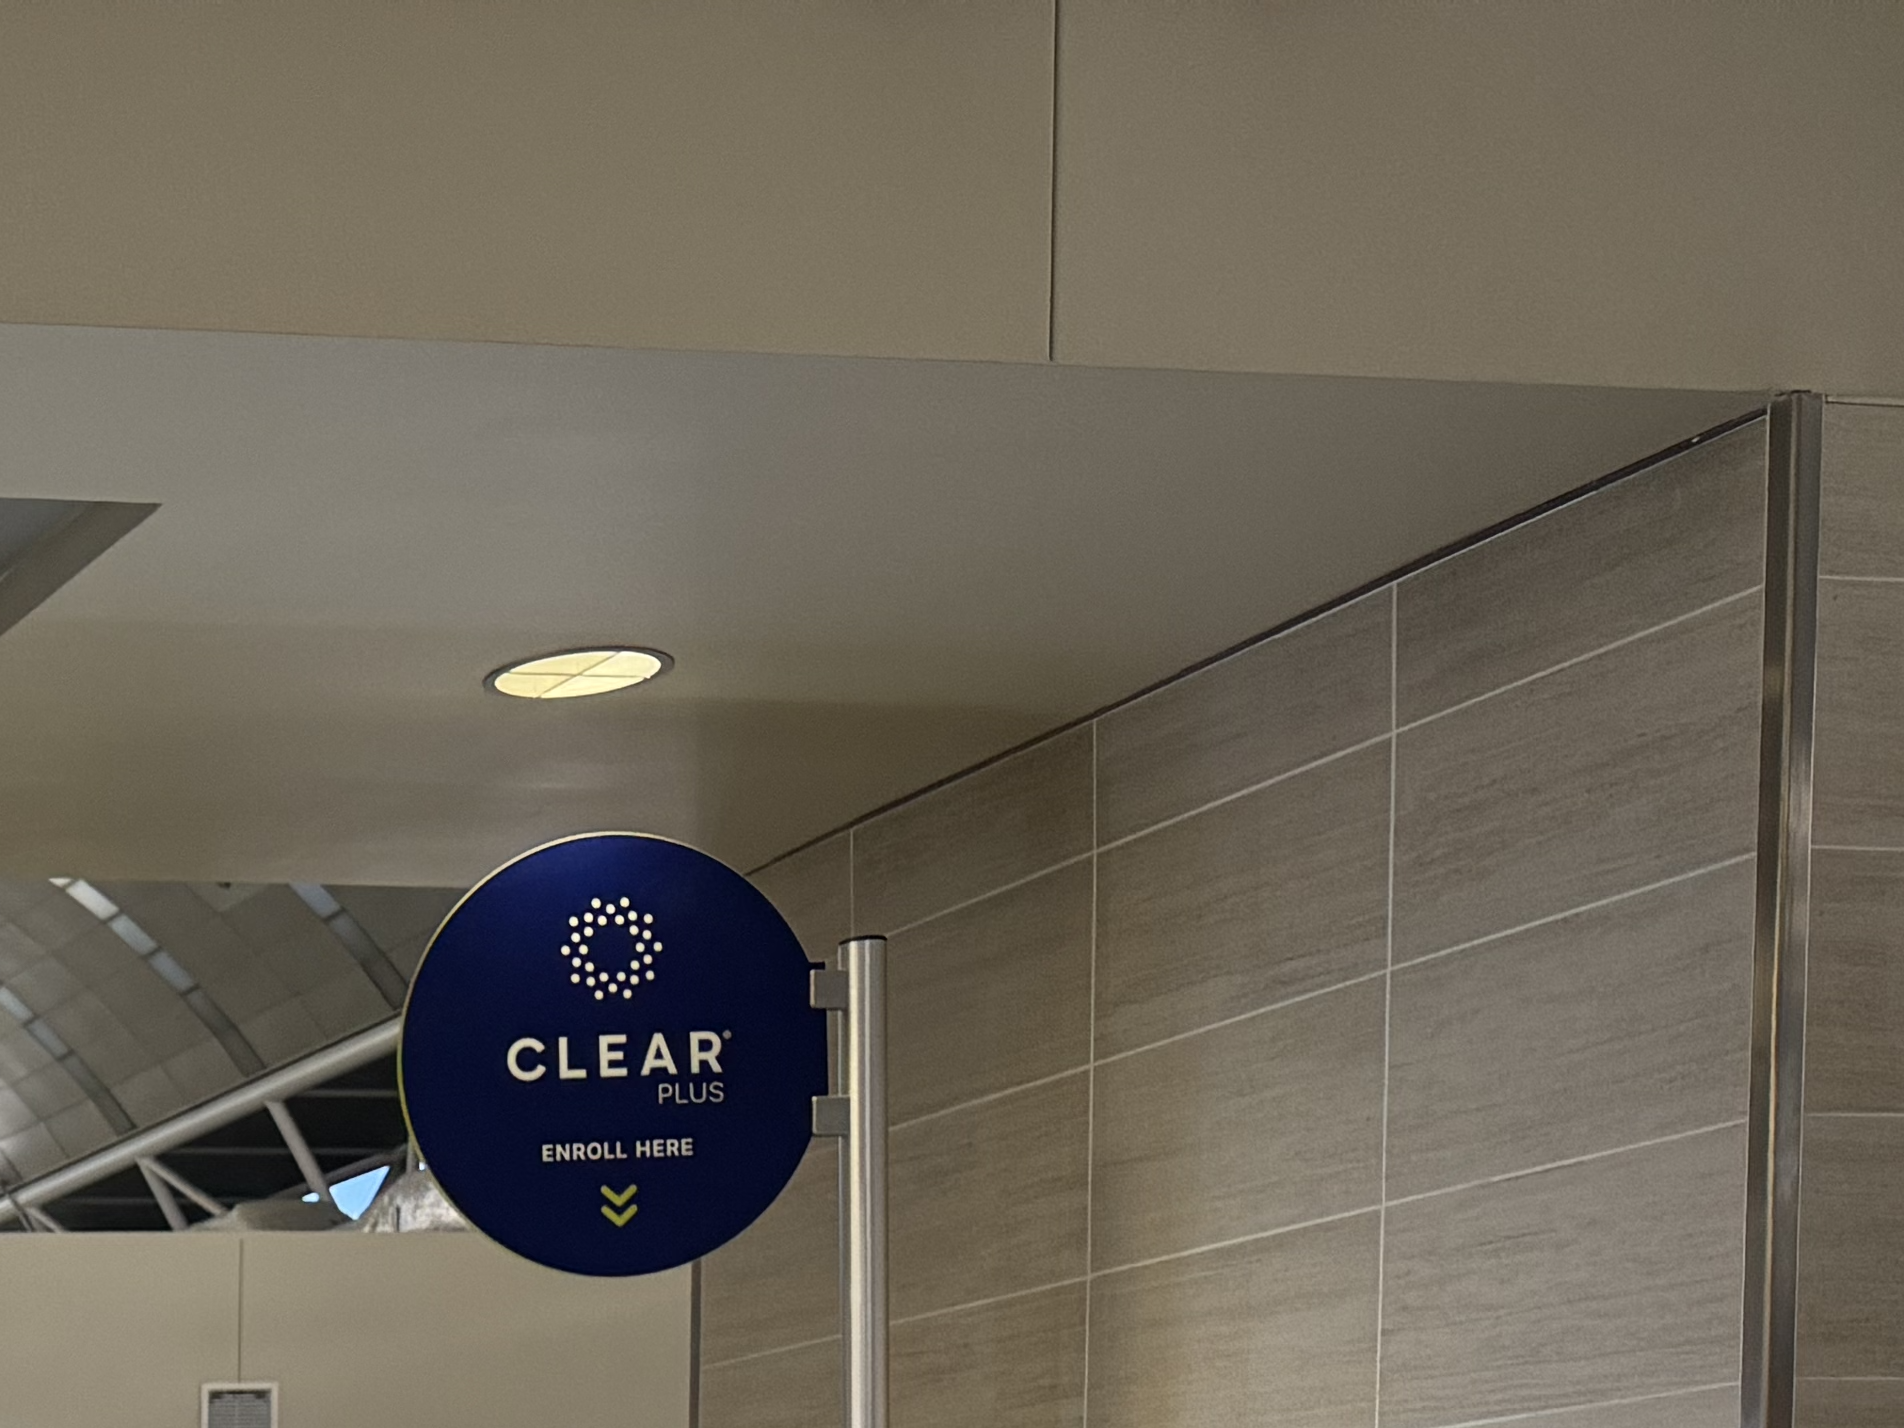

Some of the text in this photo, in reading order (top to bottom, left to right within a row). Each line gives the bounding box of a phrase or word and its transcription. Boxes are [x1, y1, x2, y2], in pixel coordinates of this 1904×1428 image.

[507, 1030, 724, 1082] CLEAR
[658, 1082, 725, 1104] PLUS
[541, 1138, 694, 1162] ENROLL HERE
